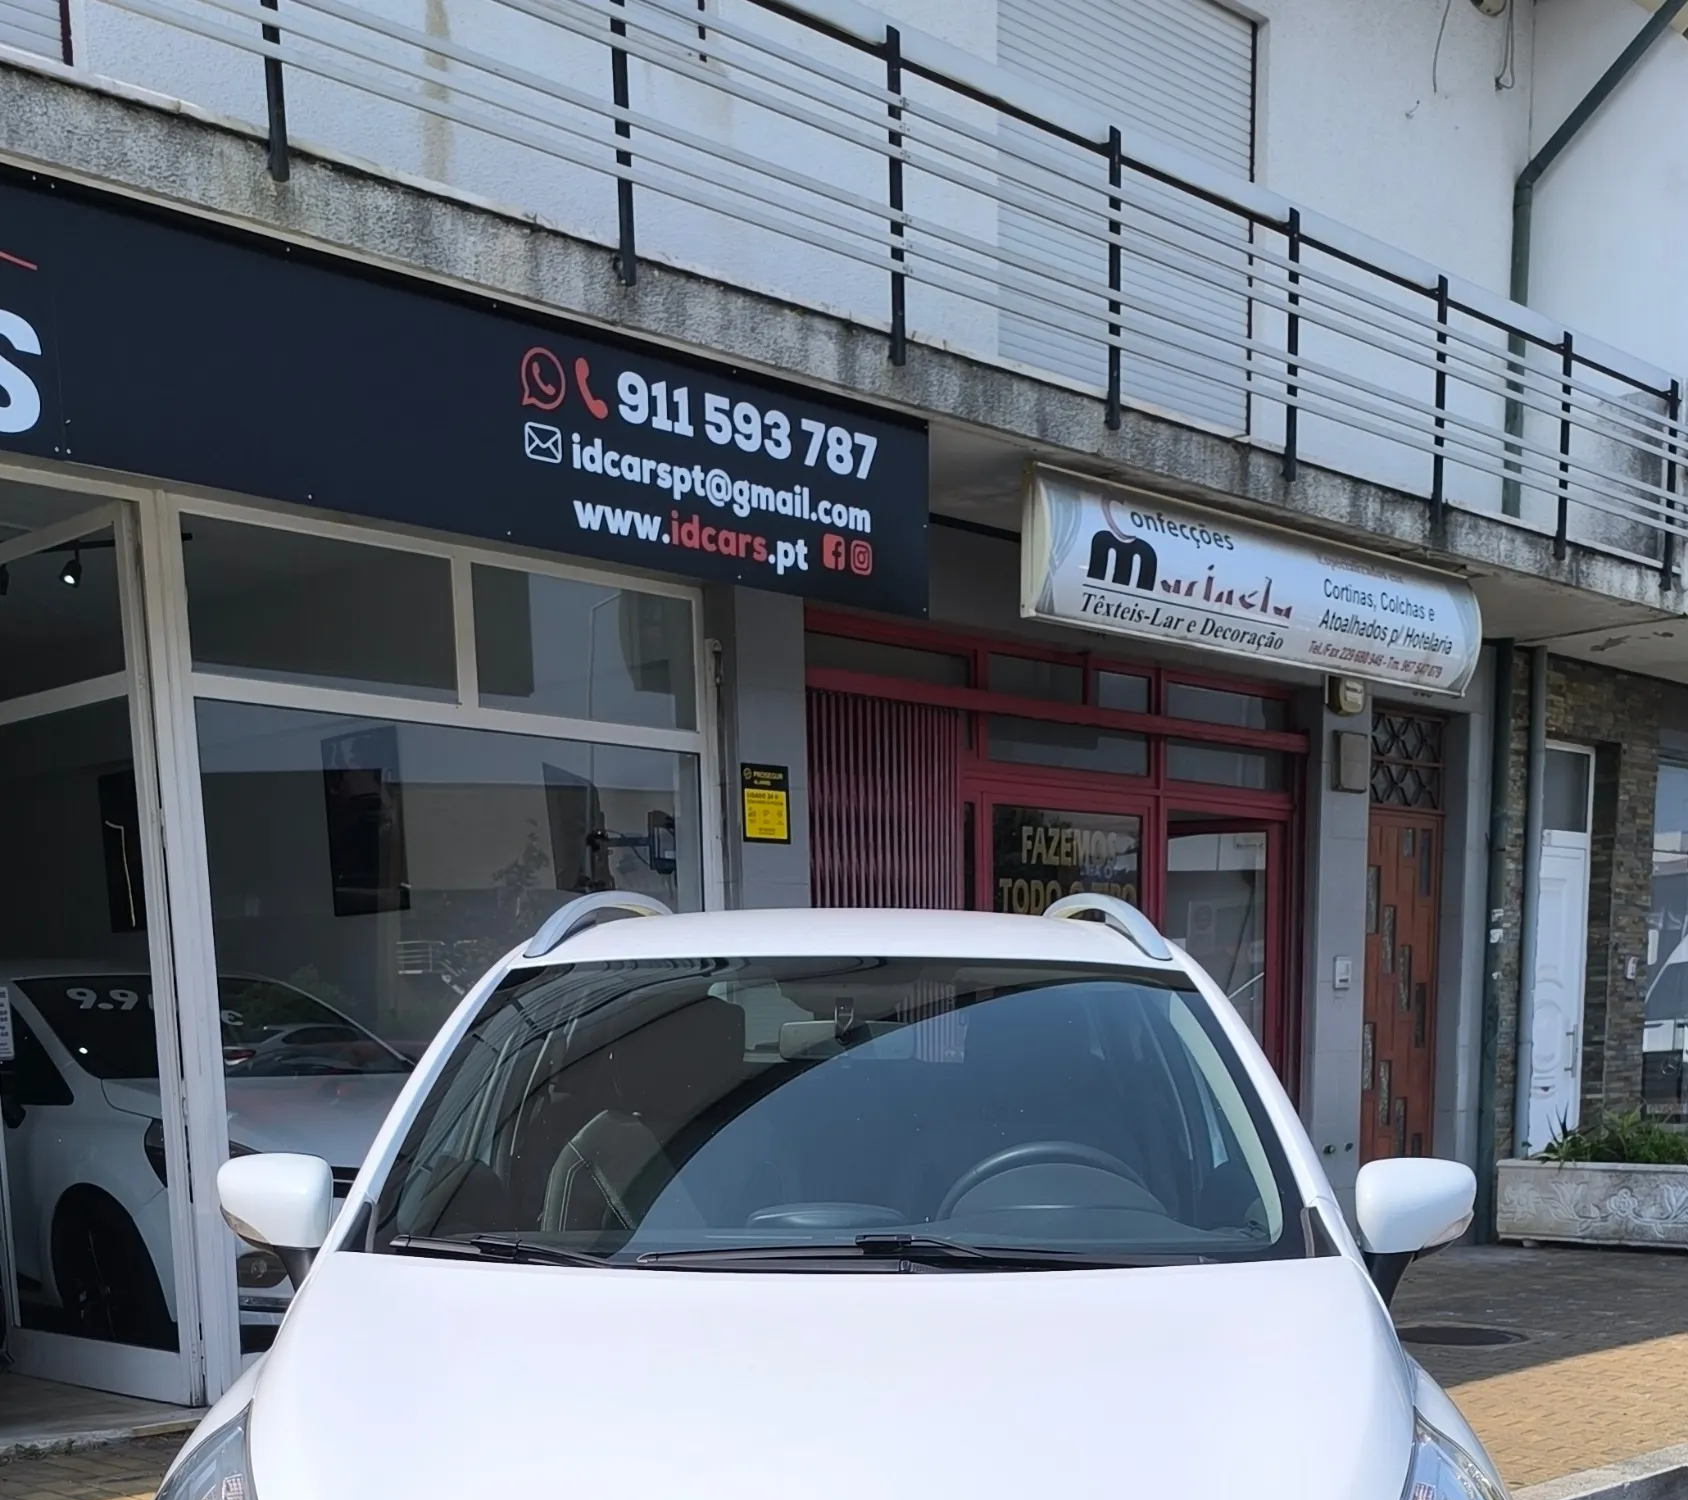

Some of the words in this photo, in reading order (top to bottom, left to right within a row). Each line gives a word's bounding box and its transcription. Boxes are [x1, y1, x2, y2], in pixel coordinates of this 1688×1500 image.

[617, 371, 694, 437] 911
[704, 392, 792, 460] 593
[800, 418, 878, 480] 787
[572, 433, 871, 534] idcarspt@gmail.com
[573, 500, 809, 575] www.idcars.pt
[1080, 592, 1185, 631] Têxteis-Lar
[1187, 620, 1197, 634] e
[1200, 617, 1284, 651] Decoração
[1323, 578, 1377, 612] Cortinas,
[1380, 592, 1425, 620] Colchas
[1428, 607, 1435, 622] e
[1318, 608, 1388, 641] Atoalhados
[1403, 626, 1453, 655] Hotelaria
[1022, 826, 1117, 867] FAZEMOS
